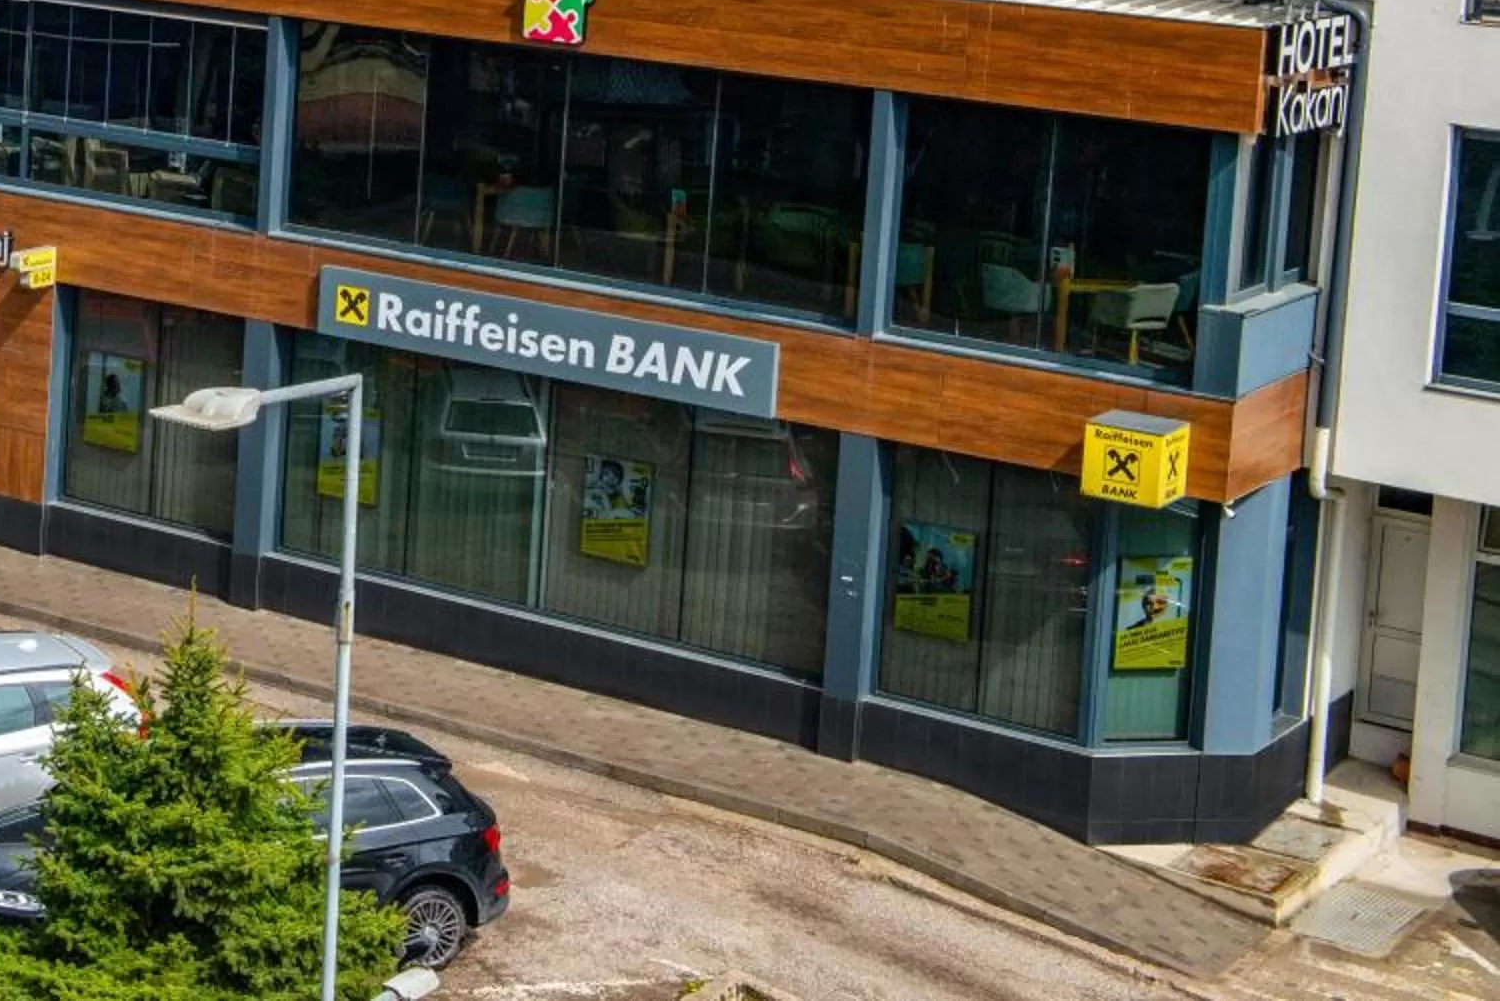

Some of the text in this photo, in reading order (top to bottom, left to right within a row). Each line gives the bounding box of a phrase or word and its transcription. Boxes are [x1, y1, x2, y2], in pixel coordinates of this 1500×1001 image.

[1279, 15, 1353, 77] HOTEL
[1276, 70, 1349, 138] Kakanj
[377, 291, 752, 397] Raiffeisen BANK
[1094, 428, 1154, 448] Raiffeisen
[1101, 484, 1138, 500] BANK
